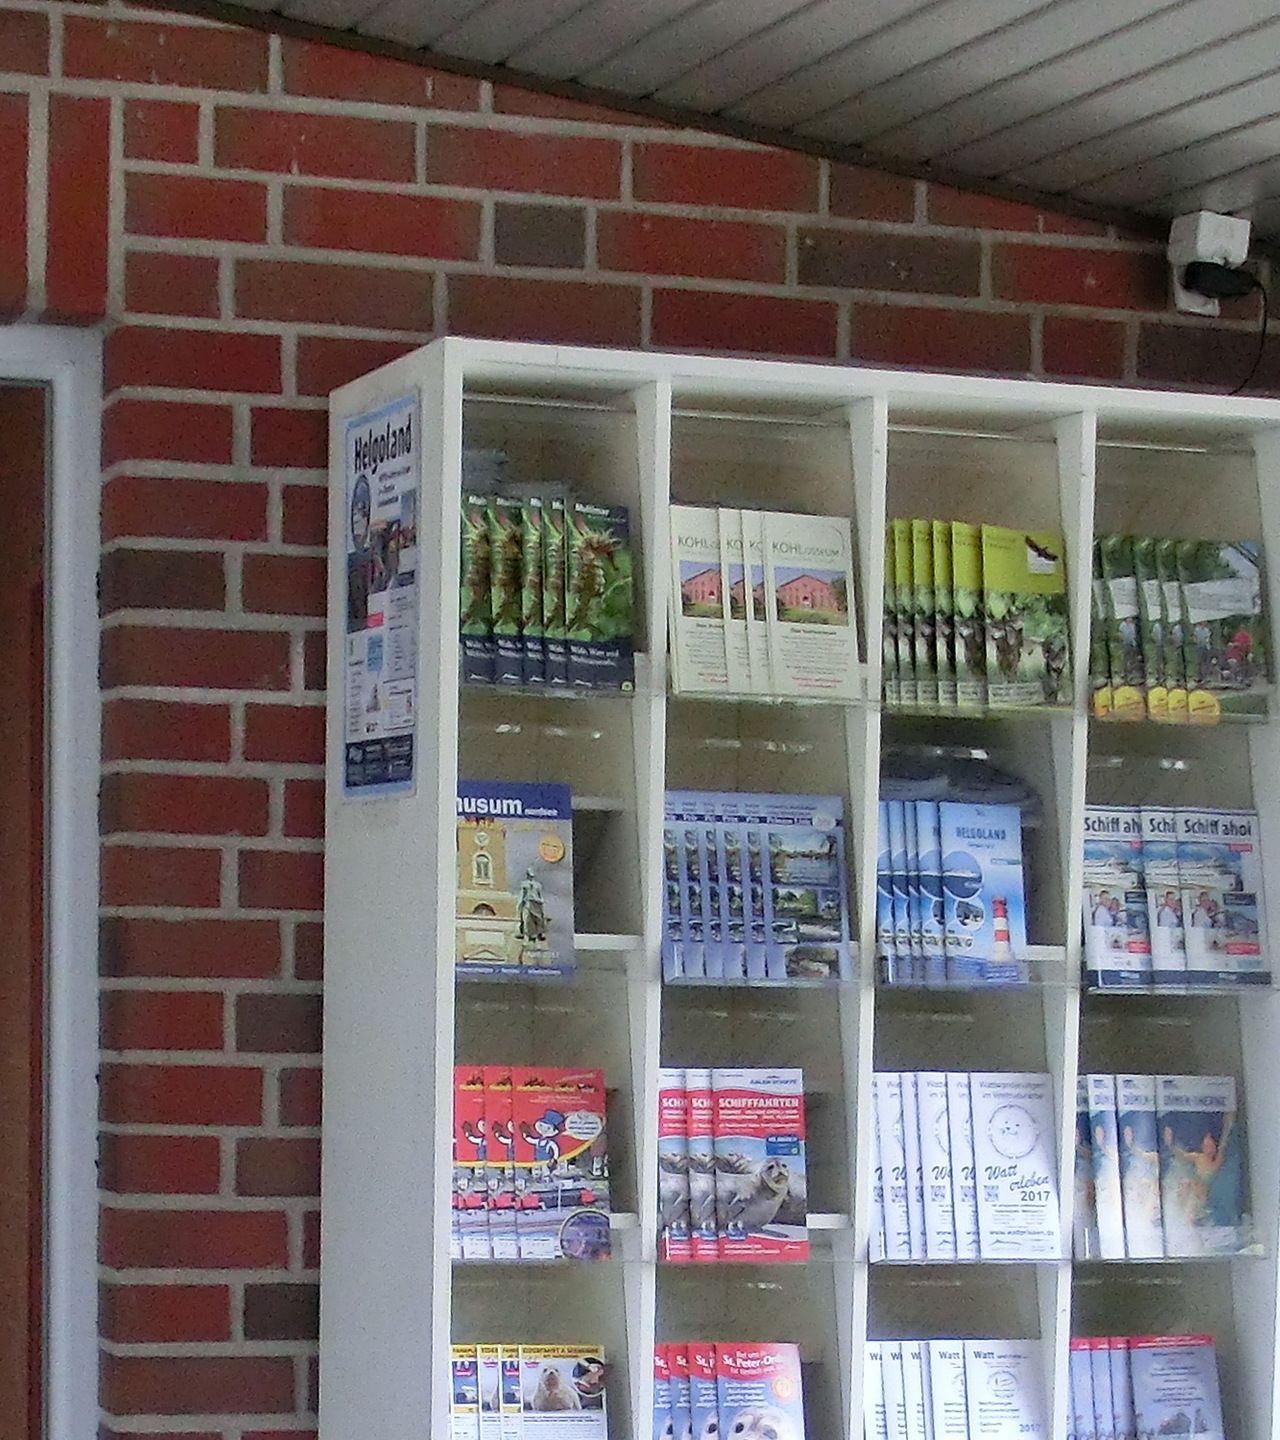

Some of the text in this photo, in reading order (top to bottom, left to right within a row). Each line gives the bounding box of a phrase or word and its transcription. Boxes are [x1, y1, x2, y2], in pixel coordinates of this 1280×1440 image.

[354, 413, 412, 475] Helgoland
[1084, 816, 1120, 833] Schiff
[1184, 818, 1252, 836] Schiff ahoi
[955, 826, 1007, 841] HELGOLAND
[984, 1164, 1018, 1181] Watt
[1009, 1171, 1049, 1192] erleben
[1020, 1190, 1051, 1202] 2017
[974, 1350, 995, 1360] Watt
